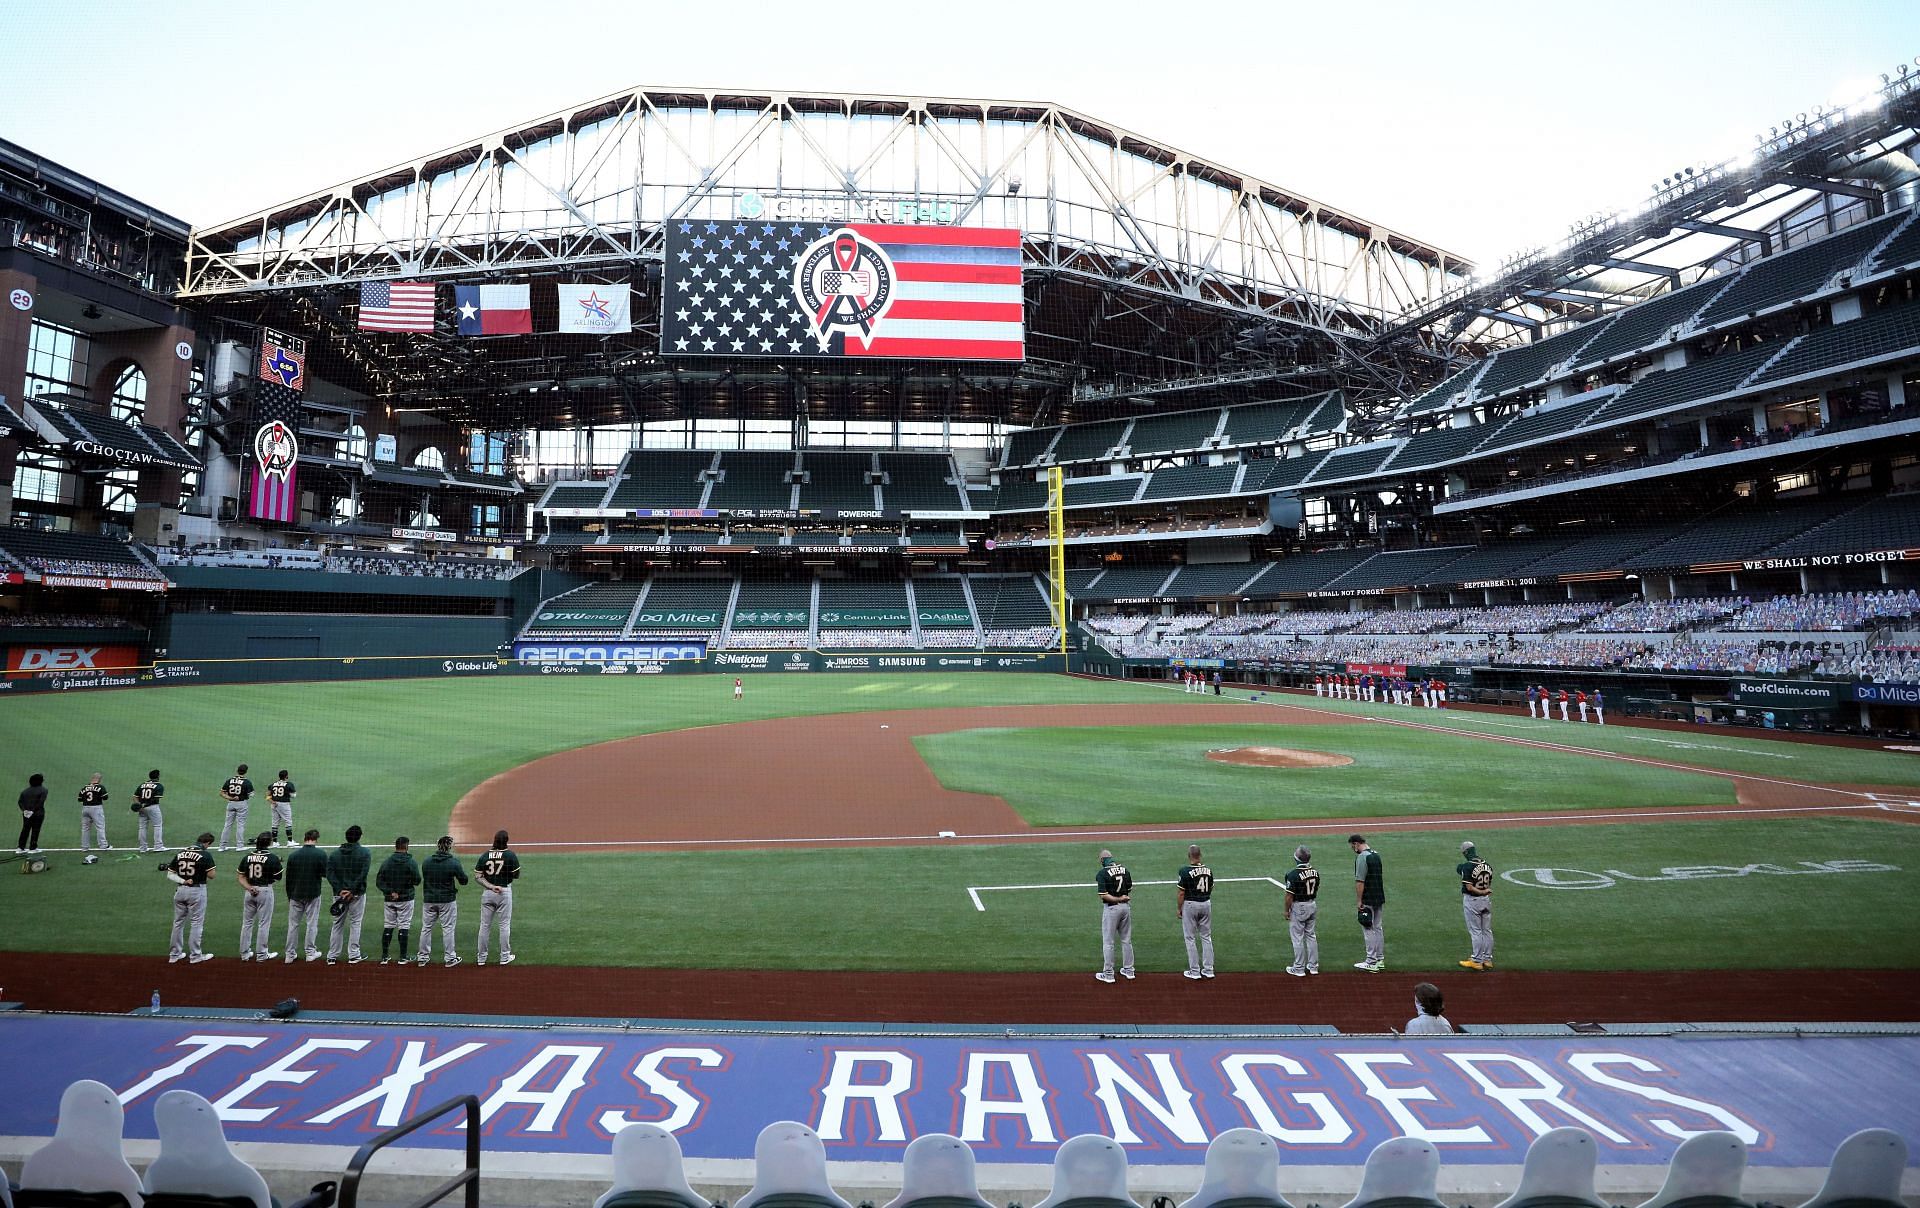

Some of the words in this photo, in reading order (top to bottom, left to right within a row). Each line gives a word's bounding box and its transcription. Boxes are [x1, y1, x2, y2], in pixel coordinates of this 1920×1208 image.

[899, 200, 951, 225] Field
[803, 246, 829, 282] SEPTEMBER
[866, 252, 888, 280] FORGET
[13, 292, 30, 307] 29
[878, 284, 888, 301] NOT
[806, 295, 819, 310] 2001
[857, 303, 880, 320] SHALL
[178, 345, 189, 356] 10
[81, 441, 153, 464] CHOCTAW
[838, 510, 883, 518] POWERADE
[465, 535, 501, 543] PLUCKERS
[1743, 561, 1762, 570] WE
[1766, 557, 1808, 569] SHALL
[1812, 555, 1840, 566] NOT
[1845, 550, 1906, 564] FORGET
[45, 576, 107, 588] WHATABURGER
[110, 579, 165, 592] WHATABURGER
[1463, 580, 1504, 589] SEPTEMBER
[1519, 577, 1537, 585] 2001
[667, 613, 717, 623] Mitel
[843, 613, 907, 622] CenturyLink
[933, 613, 970, 622] Ashley
[18, 647, 102, 670] DEX
[518, 647, 607, 666] GEICO
[612, 647, 701, 666] GEICO
[726, 654, 769, 664] National
[878, 657, 926, 666] SAMSUNG
[455, 662, 481, 671] Globe
[482, 661, 498, 670] Life
[62, 678, 99, 690] planet
[100, 676, 136, 686] fitness
[1740, 683, 1830, 697] RoofClaim.com
[86, 791, 94, 802] 3
[141, 788, 152, 799] 10
[228, 784, 242, 795] 28
[272, 786, 285, 797] 39
[177, 861, 196, 876] 25
[248, 864, 263, 879] 18
[485, 860, 504, 876] 37
[1115, 875, 1124, 893] 7
[1196, 877, 1209, 893] 41
[1306, 878, 1316, 895] 17
[1475, 872, 1490, 890] 29
[113, 1033, 728, 1137] TEXAS
[812, 1049, 1766, 1148] RANGERS
